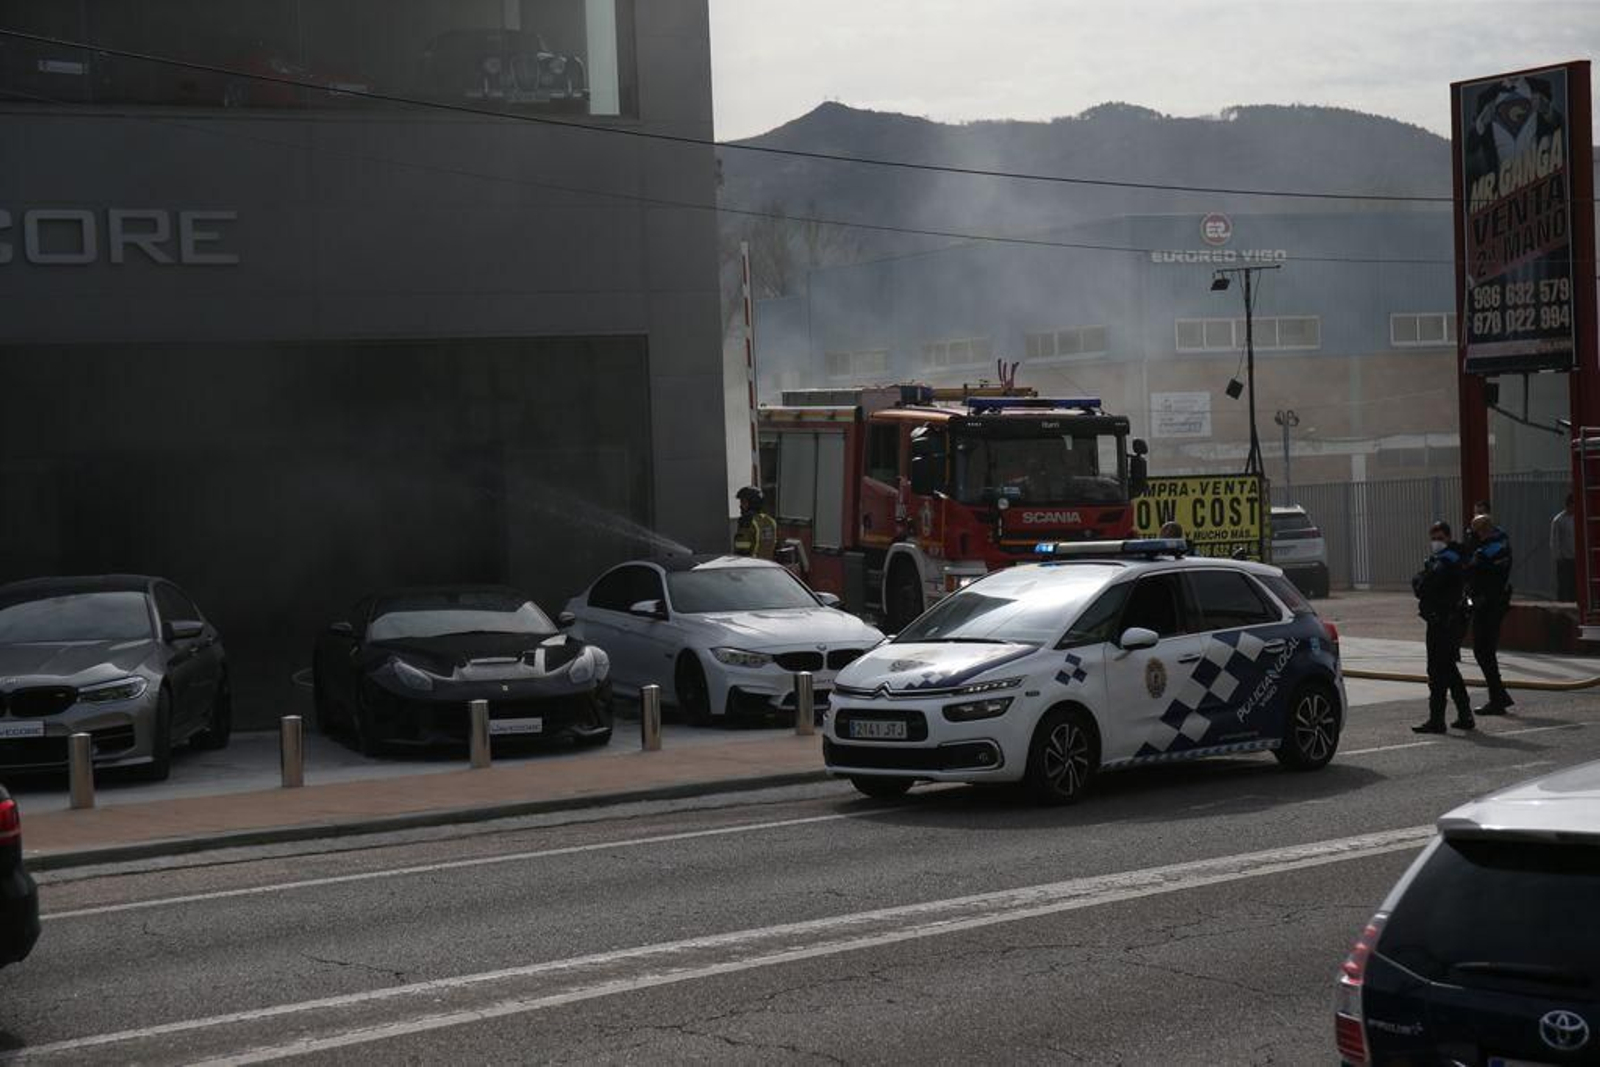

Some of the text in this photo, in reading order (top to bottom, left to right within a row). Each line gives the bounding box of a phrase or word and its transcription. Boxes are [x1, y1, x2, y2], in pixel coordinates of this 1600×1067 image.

[1474, 175, 1565, 246] VENTA
[0, 208, 240, 265] ORE
[1241, 248, 1287, 263] VIGO
[1504, 208, 1566, 265] MANO
[1022, 511, 1082, 524] SCANIA
[1137, 496, 1258, 530] OW COST
